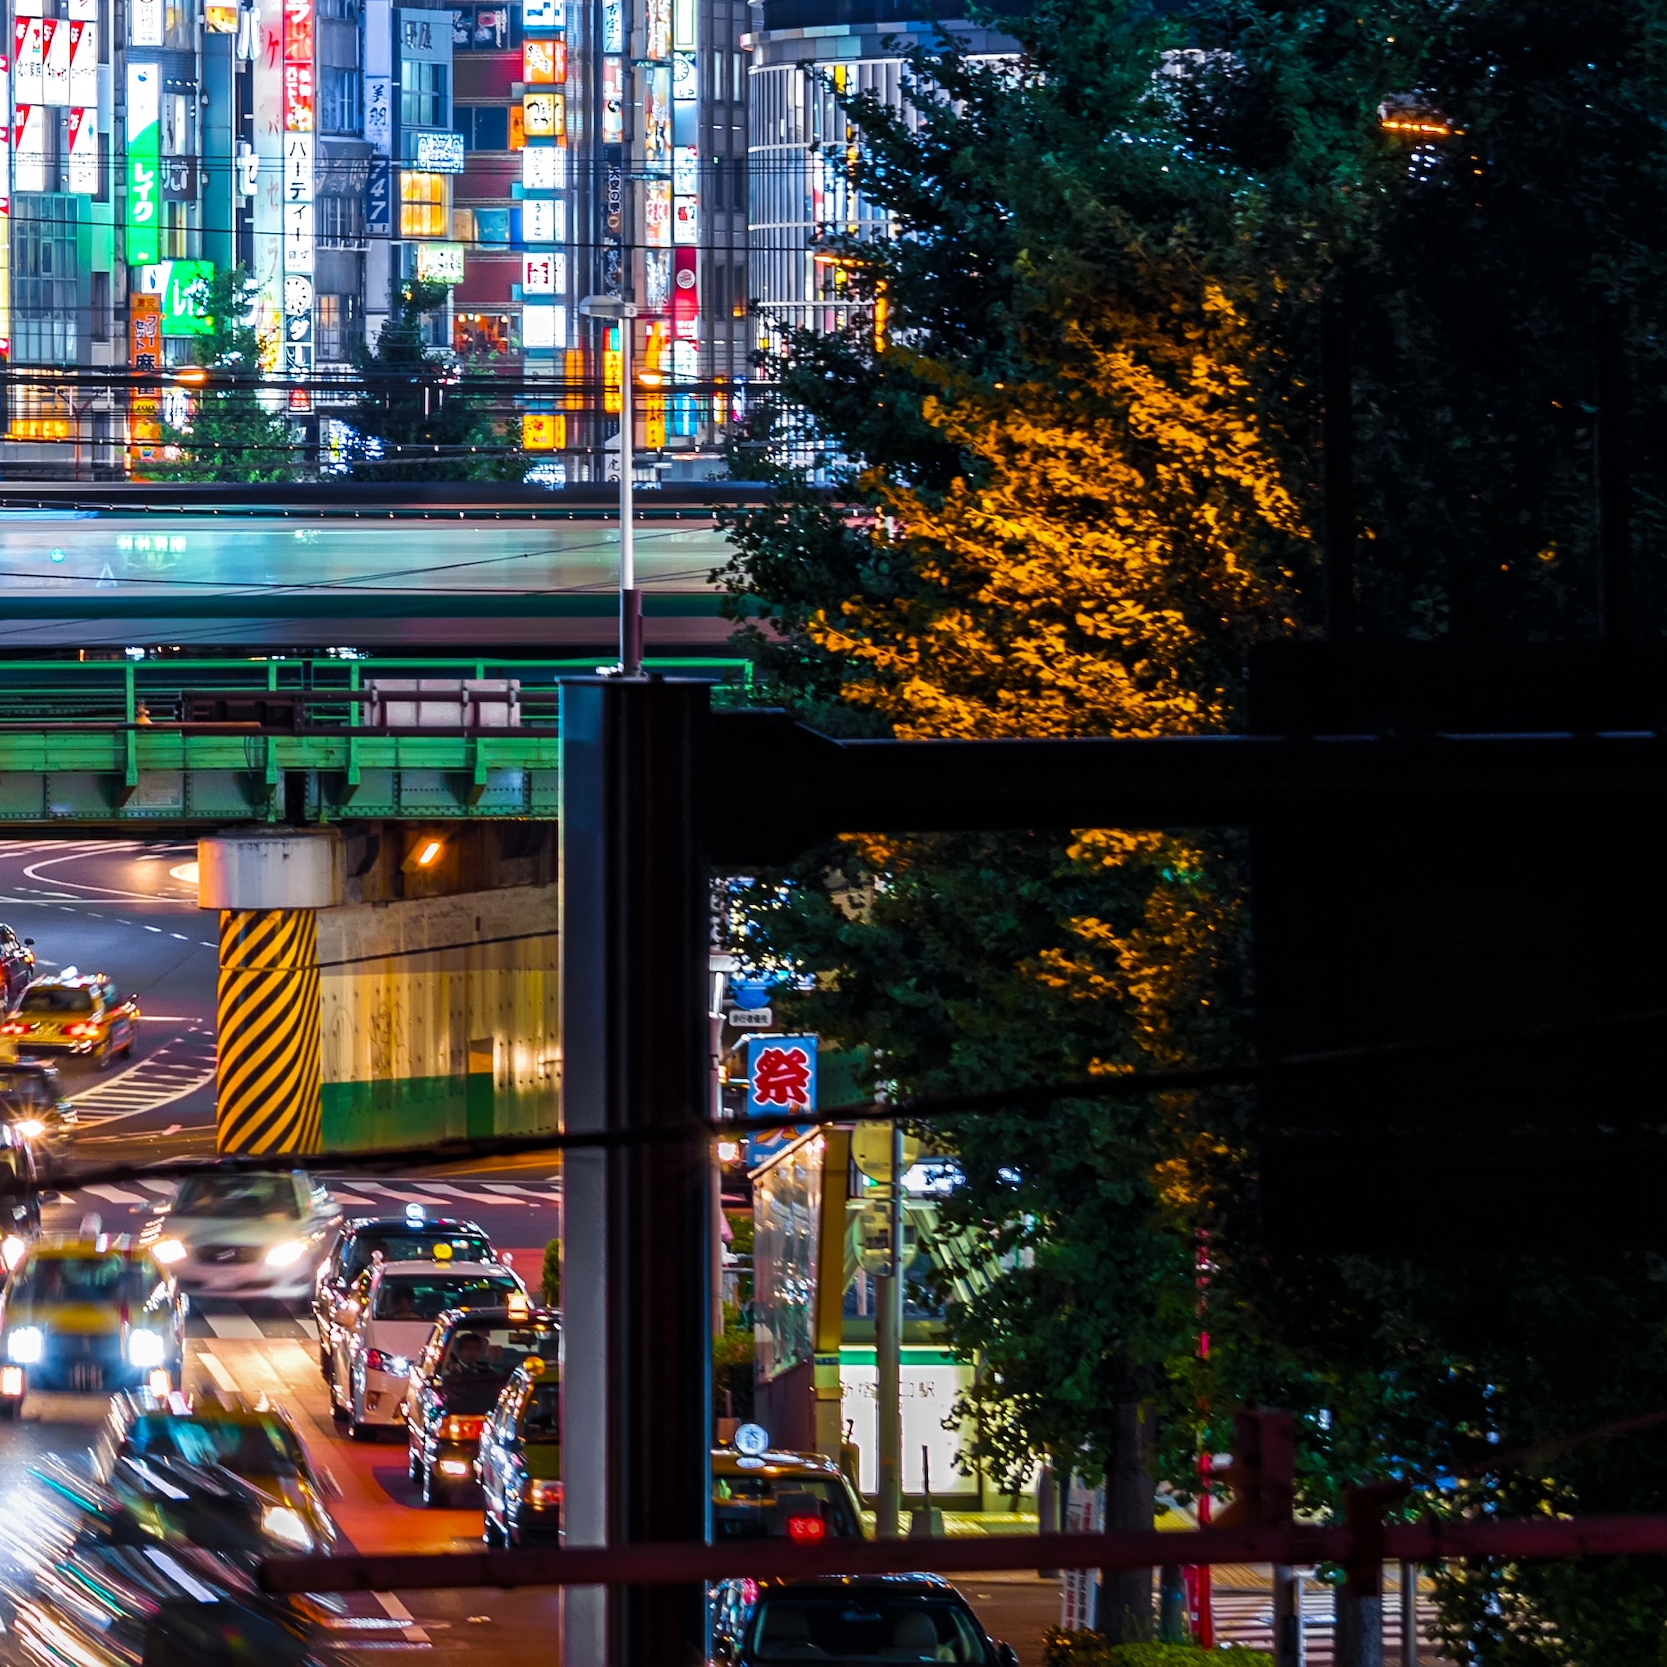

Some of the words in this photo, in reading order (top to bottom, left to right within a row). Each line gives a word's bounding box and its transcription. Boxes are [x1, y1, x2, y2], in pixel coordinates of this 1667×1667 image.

[132, 161, 154, 222] レイク
[289, 141, 308, 242] パーティー
[368, 160, 387, 220] 747
[753, 1046, 809, 1107] 祭
[841, 1380, 935, 1400] 新宿口駅
